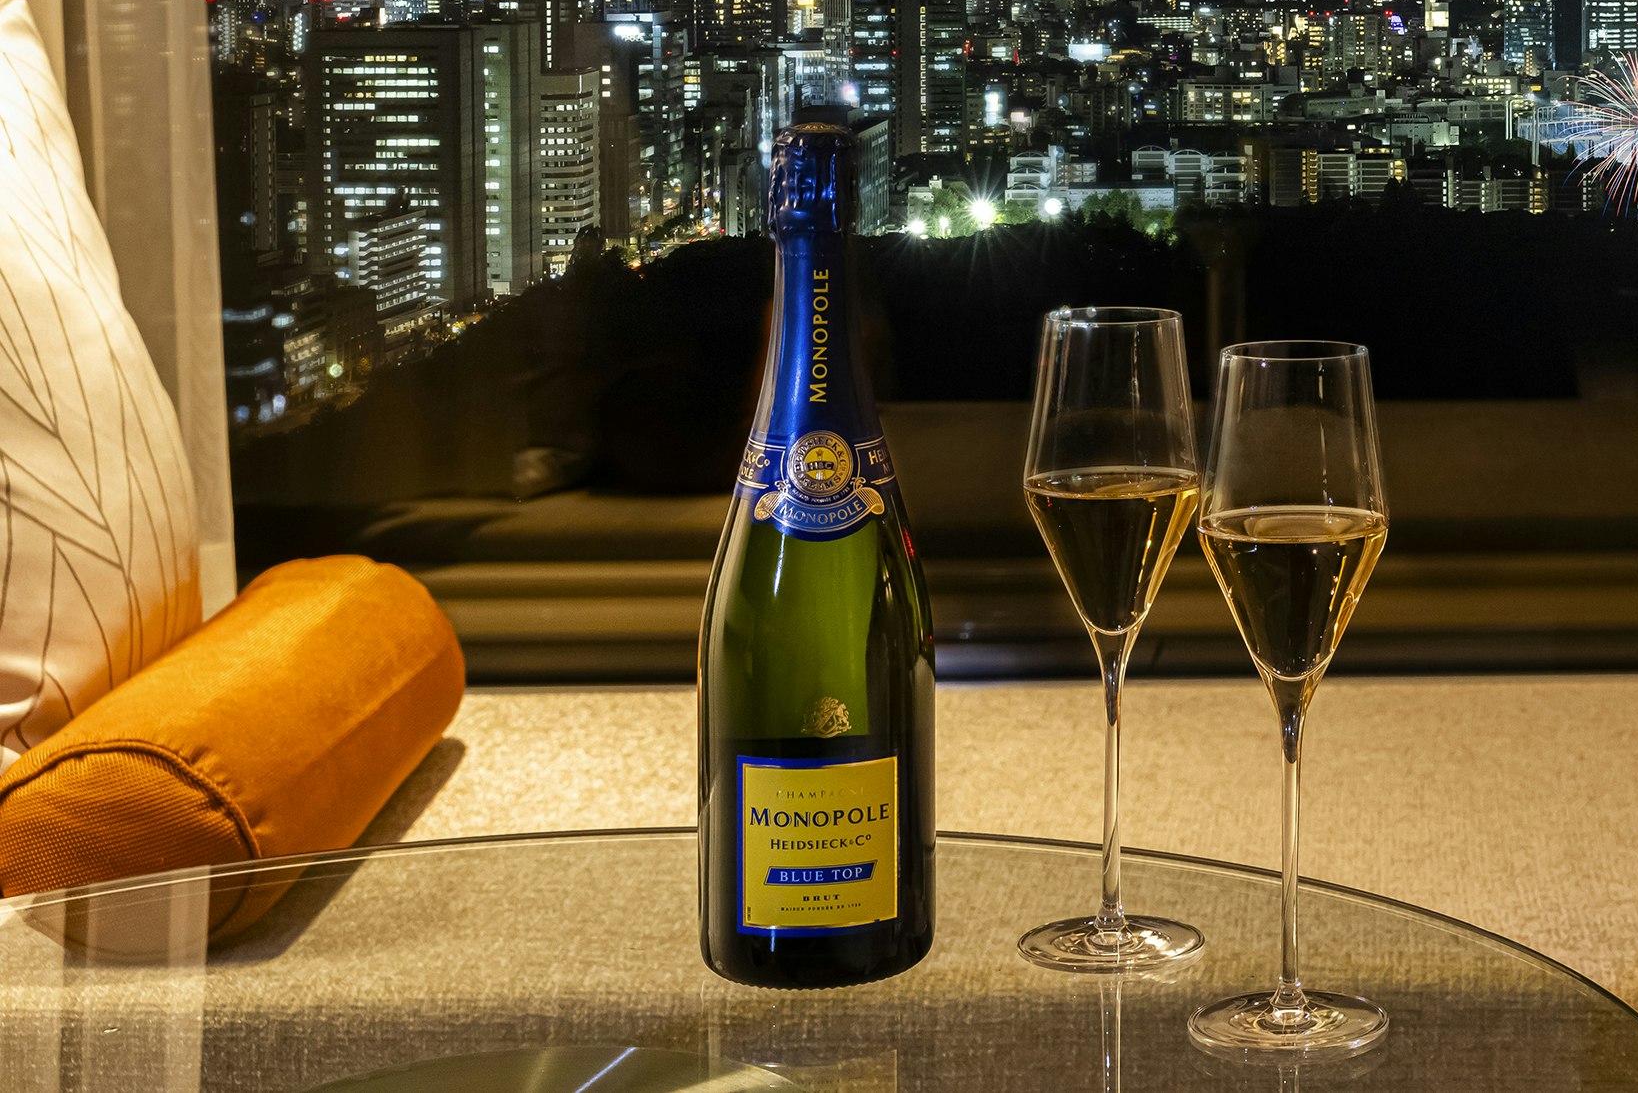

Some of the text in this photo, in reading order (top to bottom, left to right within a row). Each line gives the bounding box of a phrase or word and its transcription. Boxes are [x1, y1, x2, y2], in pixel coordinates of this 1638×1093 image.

[809, 269, 829, 403] MONOPOLE
[779, 499, 863, 524] MONOPOLE
[750, 803, 890, 827] MONOPOLE
[780, 867, 863, 883] BLUE TOP
